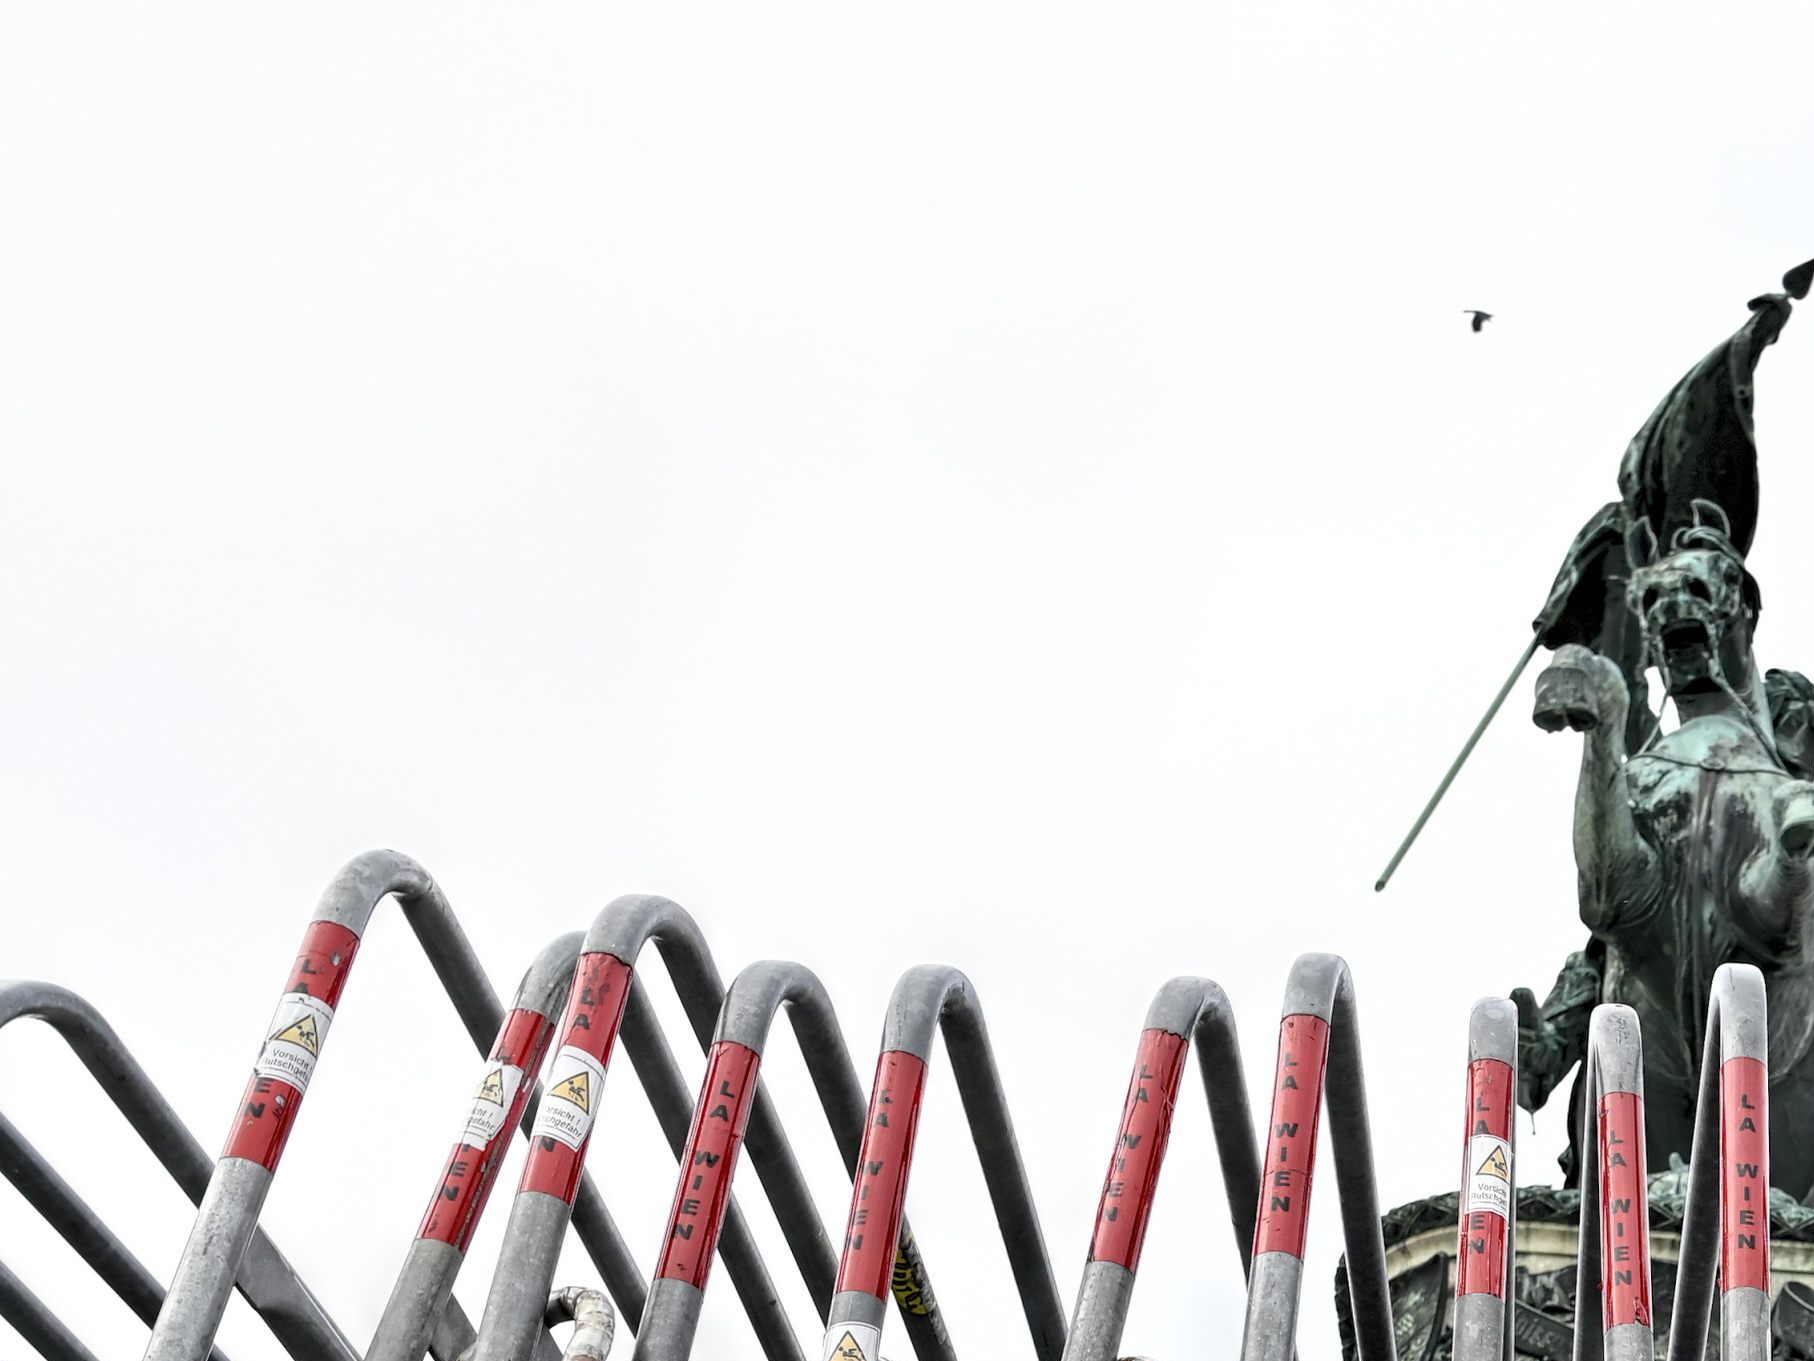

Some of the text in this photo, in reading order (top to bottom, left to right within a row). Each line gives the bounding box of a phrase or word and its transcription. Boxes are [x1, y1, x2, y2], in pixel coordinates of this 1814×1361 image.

[272, 1048, 309, 1071] Vorsicht
[574, 985, 594, 1030] LA
[545, 1104, 575, 1122] orsicht
[672, 1081, 734, 1240] LA WIEN
[851, 1088, 893, 1249] LA WIEN
[1103, 1064, 1153, 1222] LA WIEN
[1271, 1053, 1298, 1213] LA WIEN
[1735, 1094, 1758, 1250] LA WIEN
[1469, 1215, 1485, 1254] EN
[1608, 1130, 1632, 1286] LA WIEN
